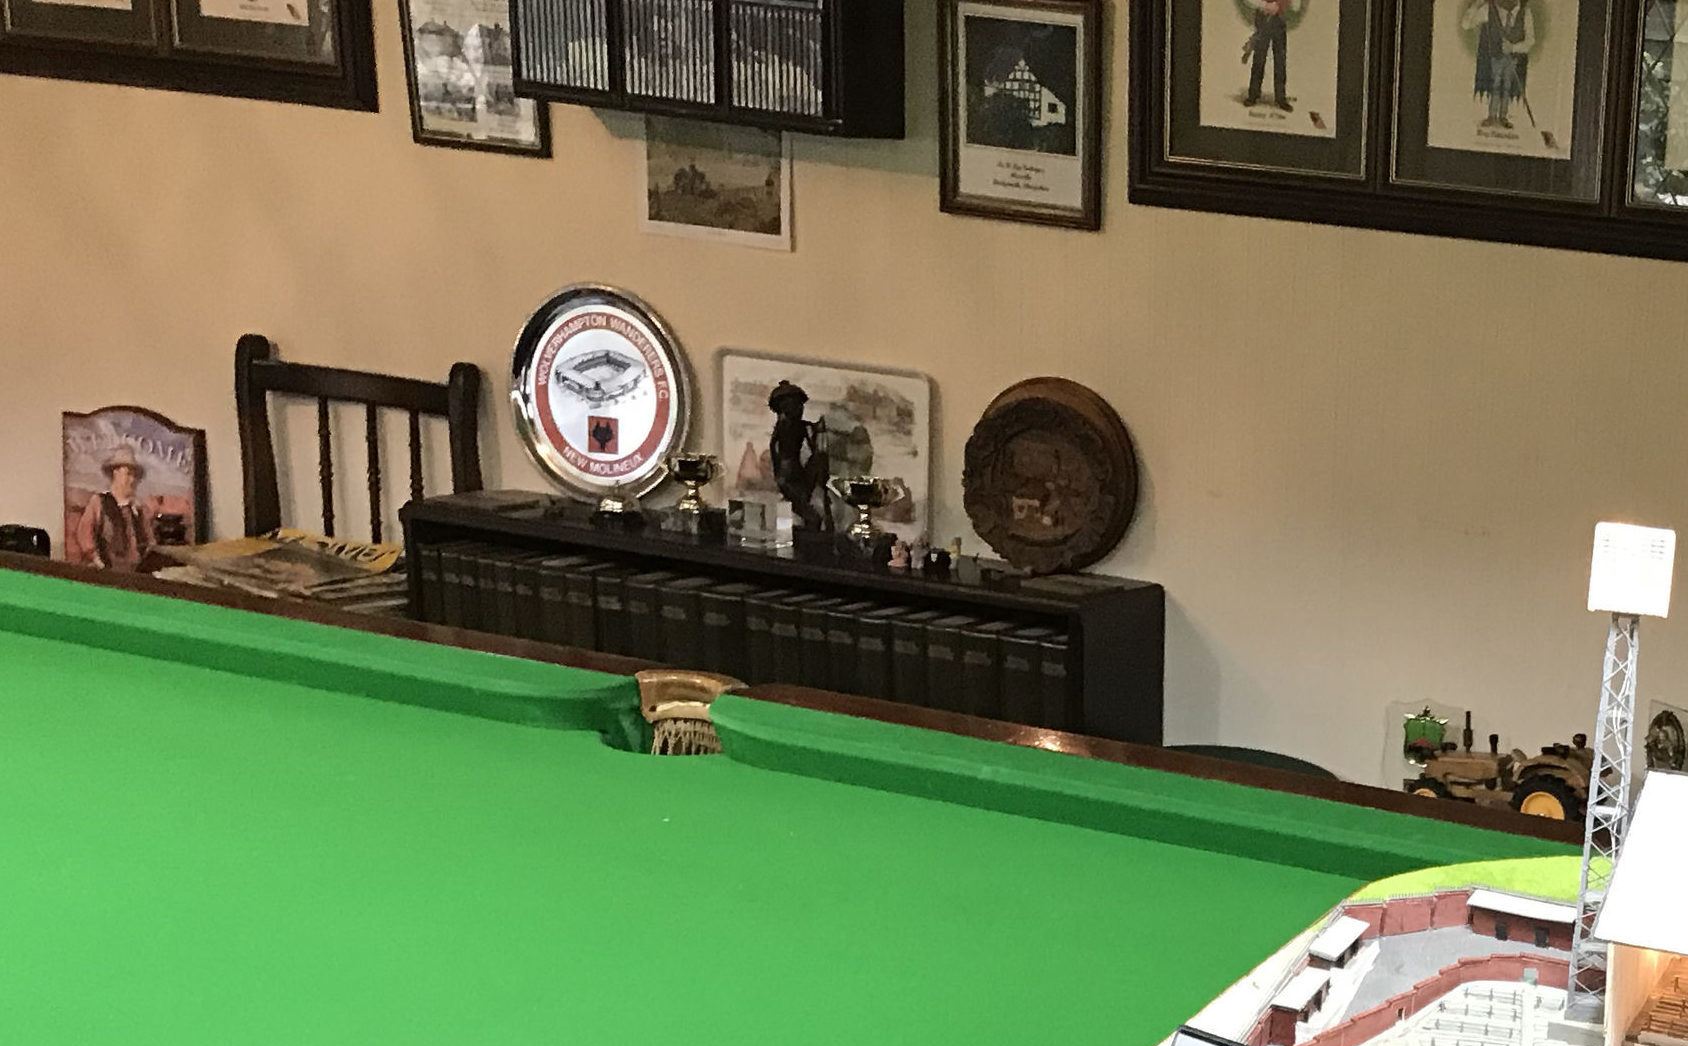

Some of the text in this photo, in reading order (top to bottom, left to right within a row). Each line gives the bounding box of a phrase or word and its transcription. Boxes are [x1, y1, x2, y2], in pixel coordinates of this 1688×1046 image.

[538, 314, 607, 385] WOLVERHAMPTON
[610, 317, 665, 380] WANDERERS
[562, 446, 644, 475] NEW MOLINEUX
